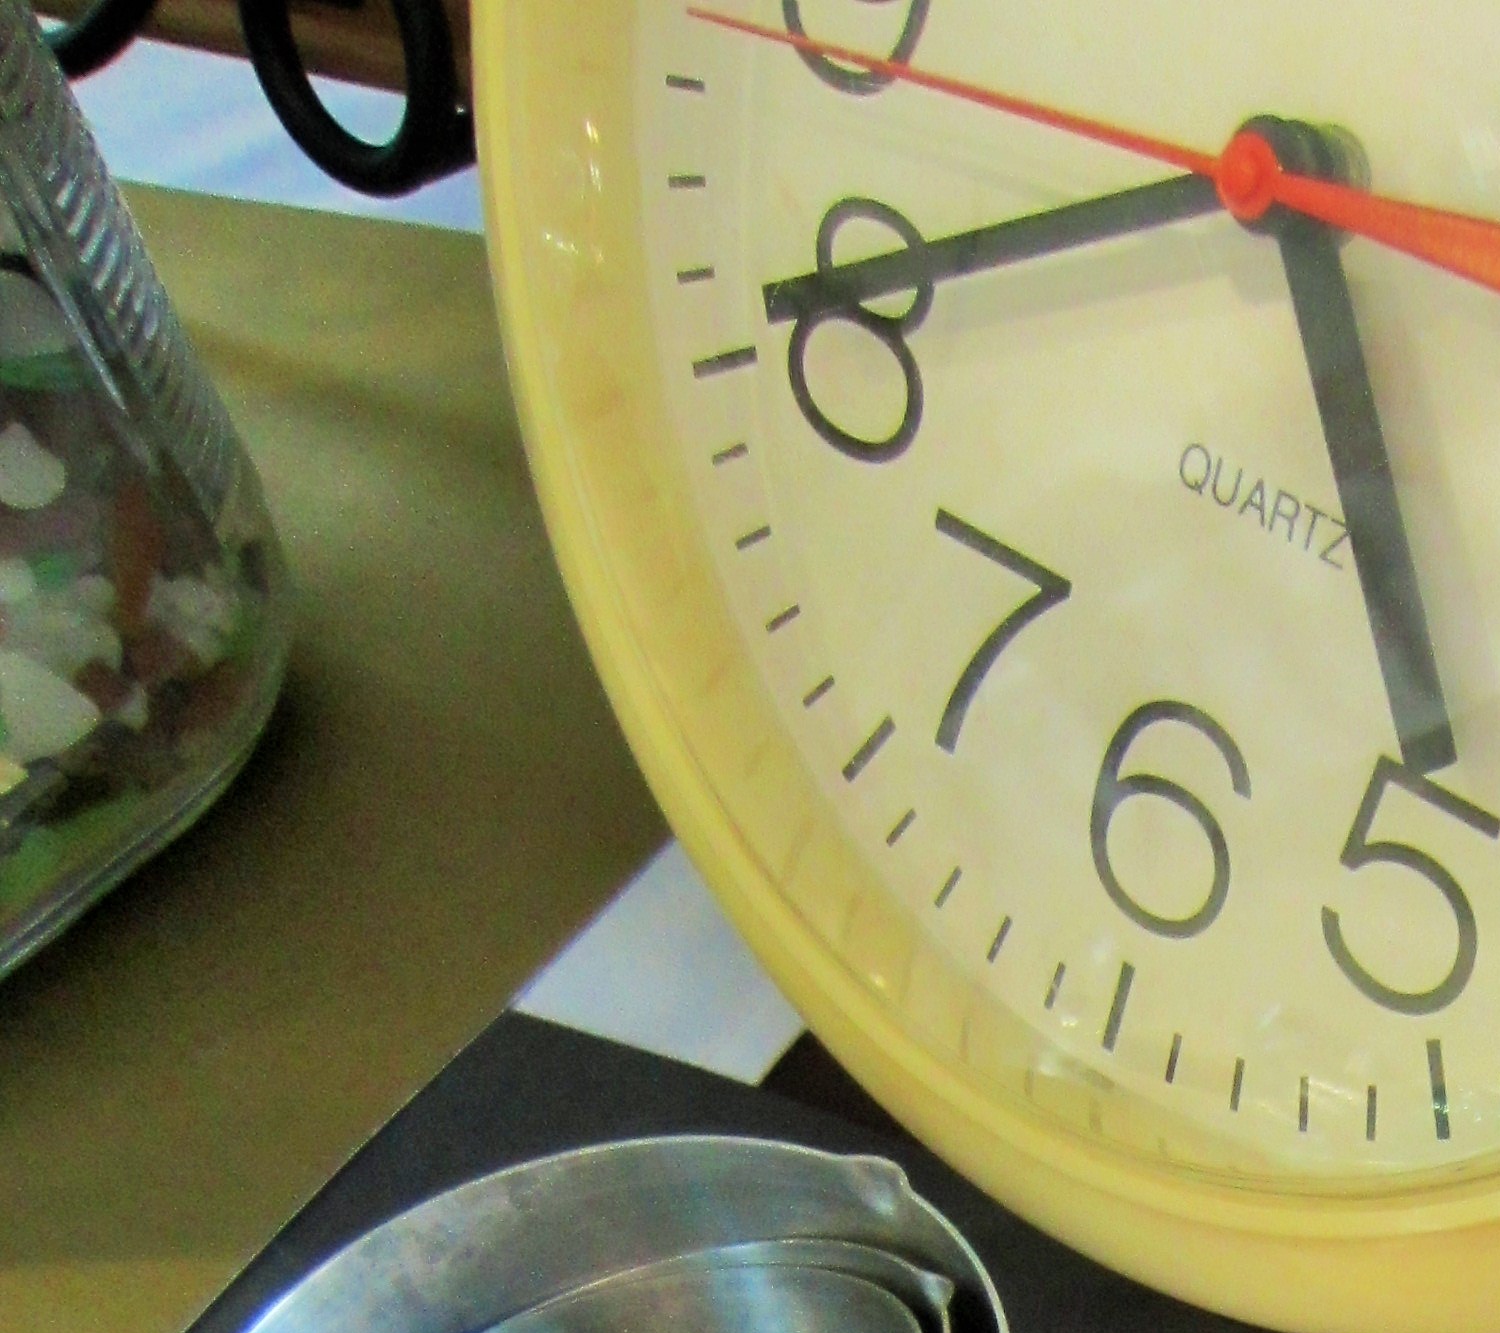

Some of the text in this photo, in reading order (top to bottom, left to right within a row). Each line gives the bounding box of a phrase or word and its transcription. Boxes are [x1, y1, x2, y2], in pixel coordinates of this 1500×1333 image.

[788, 197, 934, 465] 8
[1178, 442, 1351, 570] QUARTZ
[936, 506, 1071, 753] 7
[1089, 699, 1252, 940] 6
